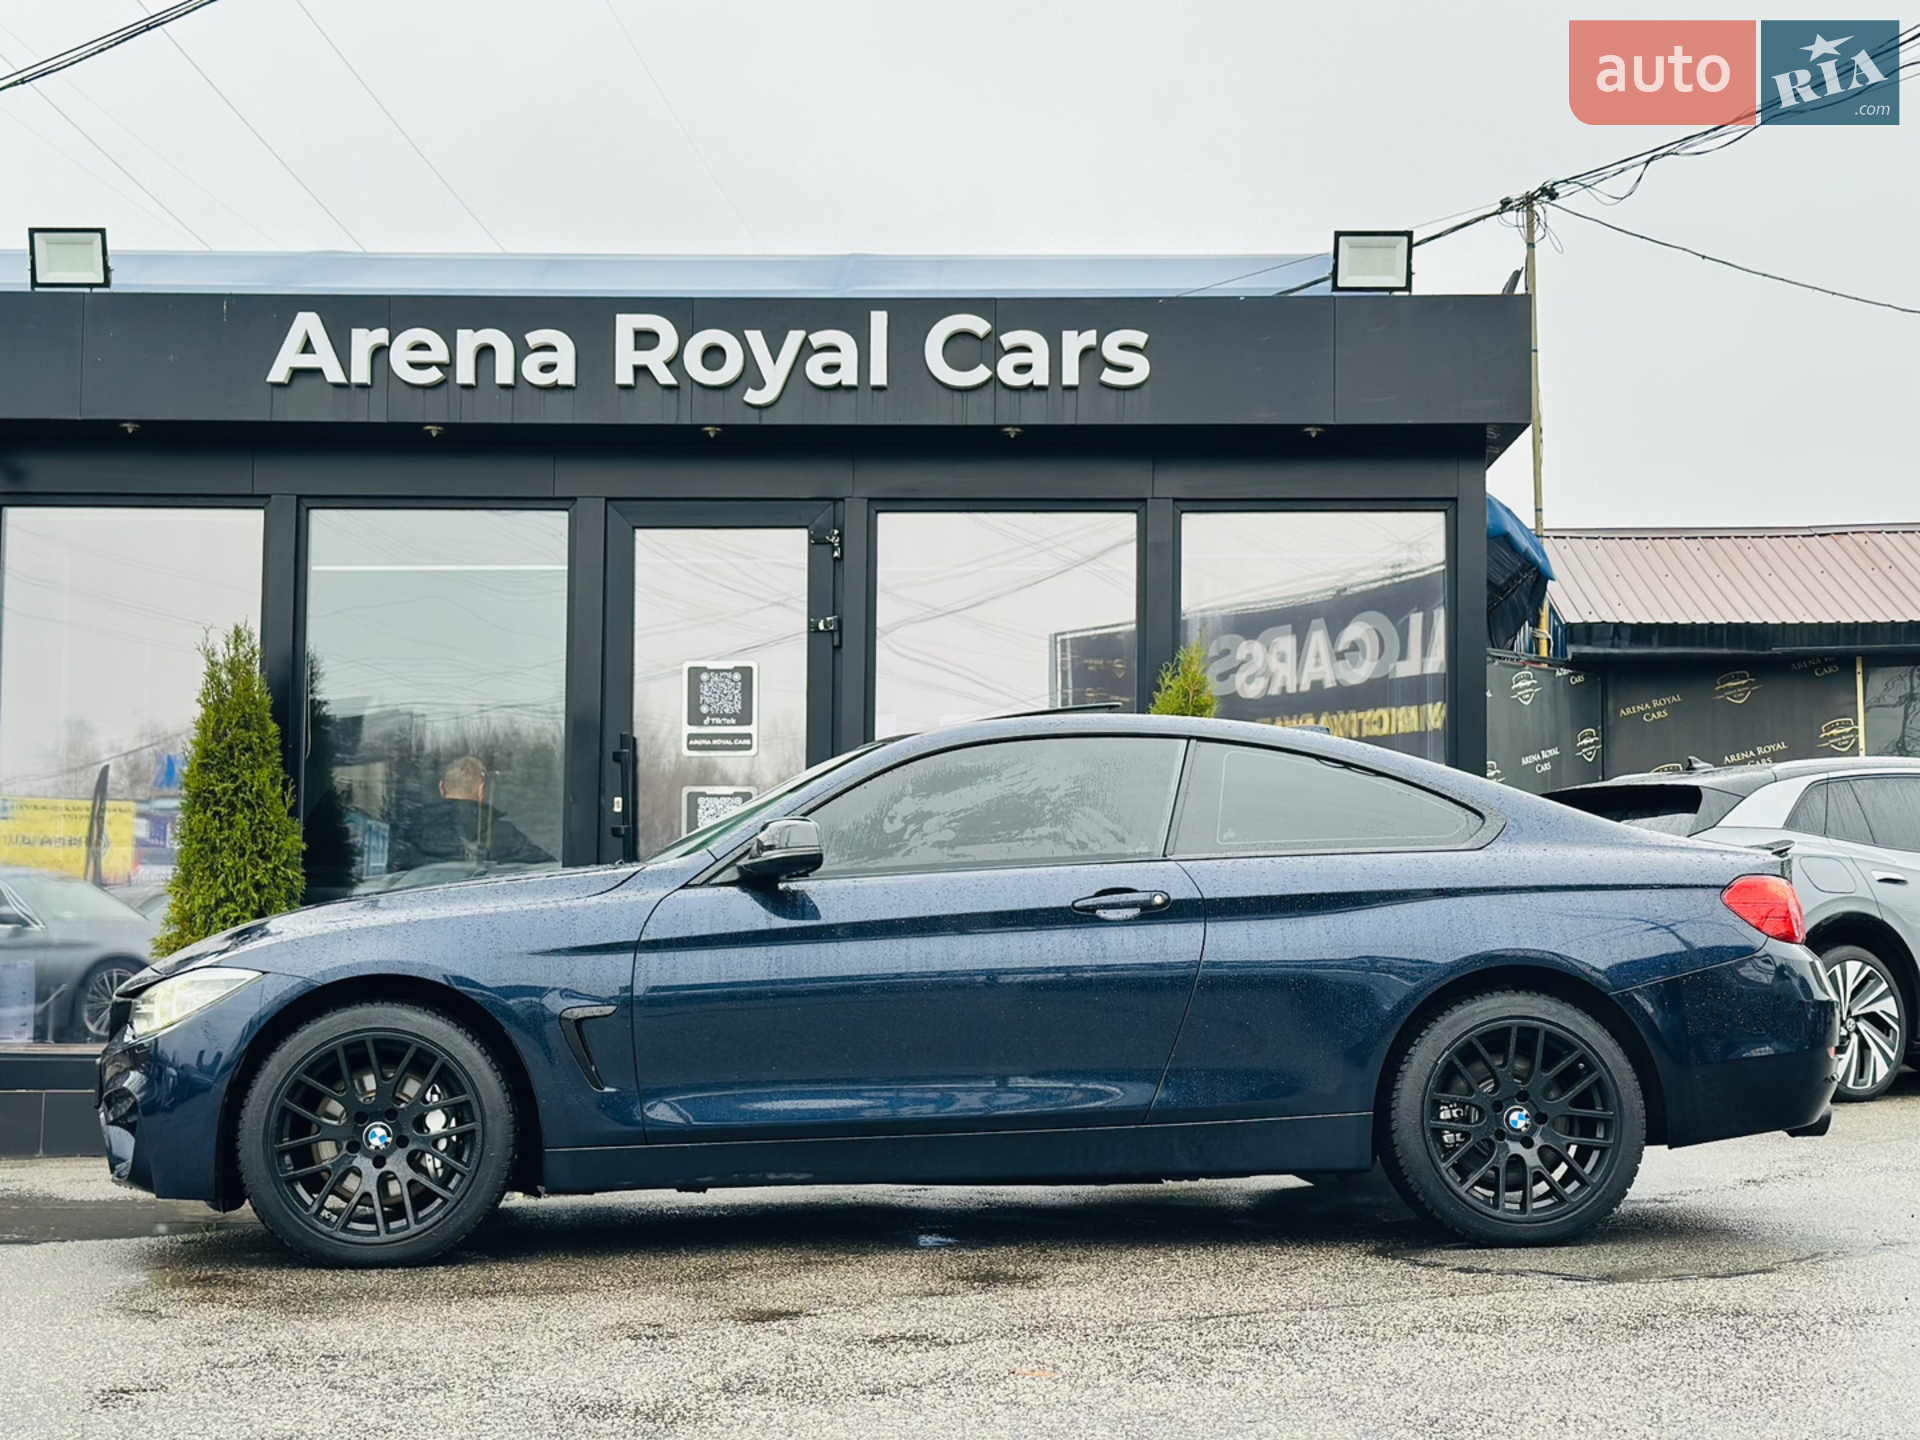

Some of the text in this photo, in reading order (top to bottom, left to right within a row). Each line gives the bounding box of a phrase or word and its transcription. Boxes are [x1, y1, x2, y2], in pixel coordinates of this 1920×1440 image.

[266, 310, 1153, 408] Arena Royal Cars
[1619, 693, 1683, 717] ARENA ROYAL
[1642, 708, 1669, 723] CARS
[1723, 741, 1788, 765] ARENA ROYAL
